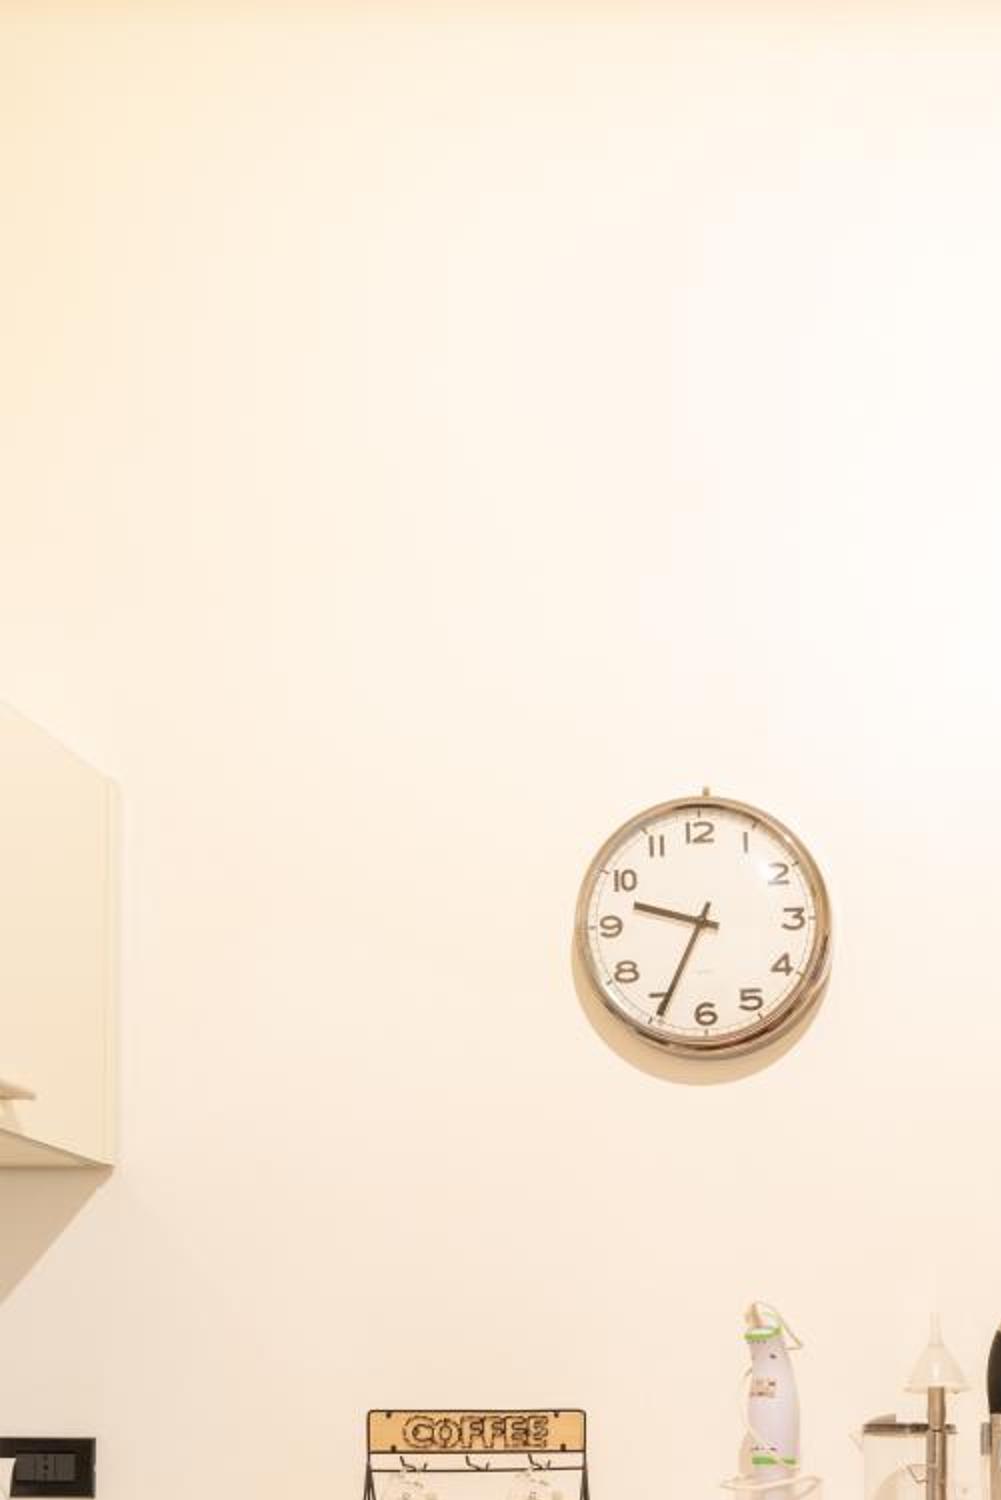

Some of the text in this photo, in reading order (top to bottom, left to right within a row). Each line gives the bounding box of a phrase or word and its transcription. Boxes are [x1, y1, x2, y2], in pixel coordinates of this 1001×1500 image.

[685, 821, 715, 844] 12
[743, 831, 749, 854] 1
[649, 834, 665, 858] 11
[613, 869, 638, 892] 10
[767, 862, 790, 886] 2
[599, 915, 624, 939] 9
[781, 906, 806, 931] 3
[613, 960, 640, 984] 8
[770, 952, 794, 977] 4
[738, 988, 764, 1011] 5
[693, 1001, 719, 1027] 6
[402, 1415, 549, 1449] COFFEE
